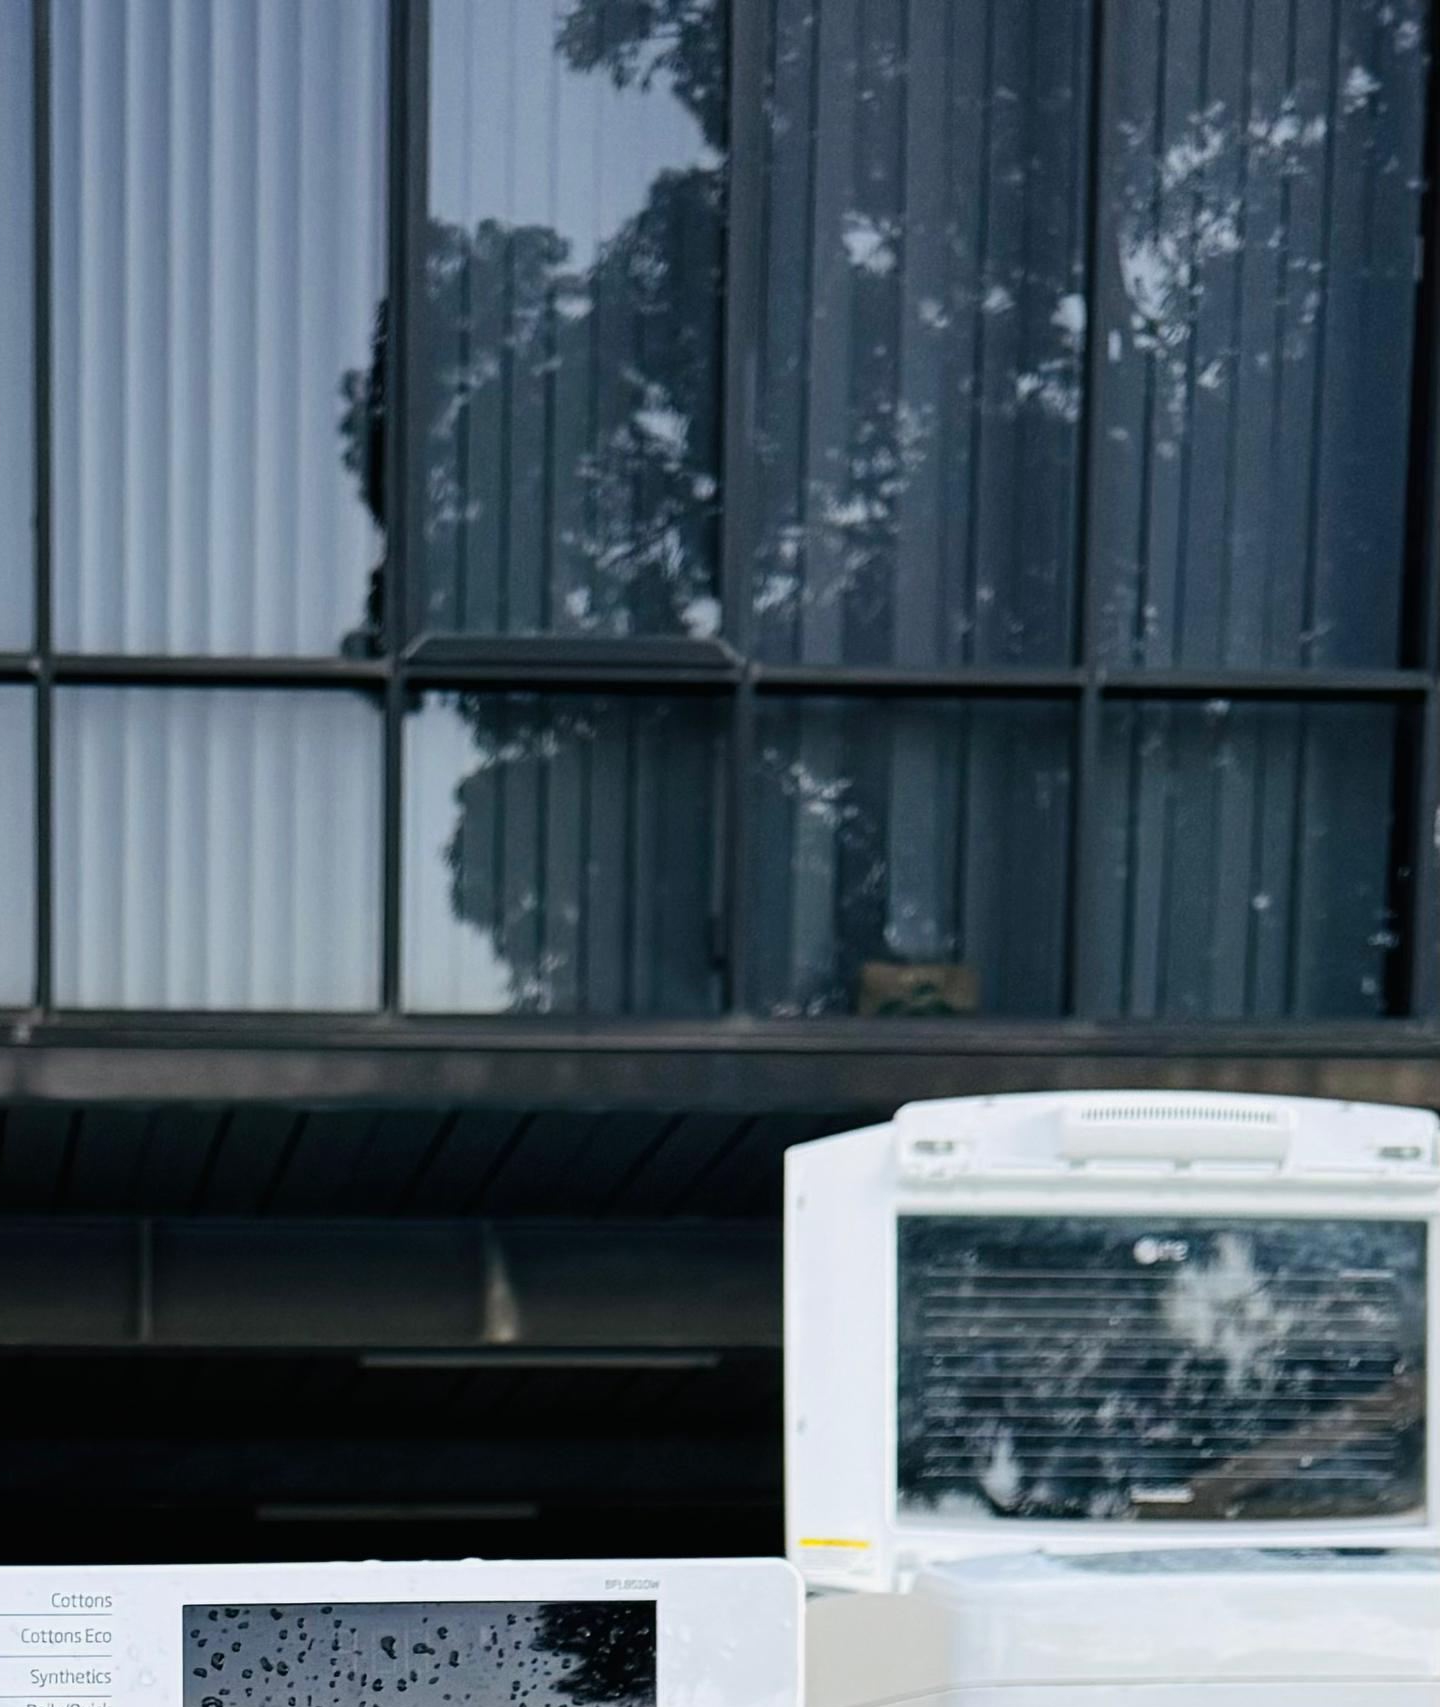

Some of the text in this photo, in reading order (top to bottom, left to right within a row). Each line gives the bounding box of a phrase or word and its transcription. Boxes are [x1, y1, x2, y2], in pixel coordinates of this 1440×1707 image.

[51, 1593, 112, 1608] Cottons
[21, 1628, 112, 1644] Cottons Eco
[30, 1669, 112, 1687] Synthetics
